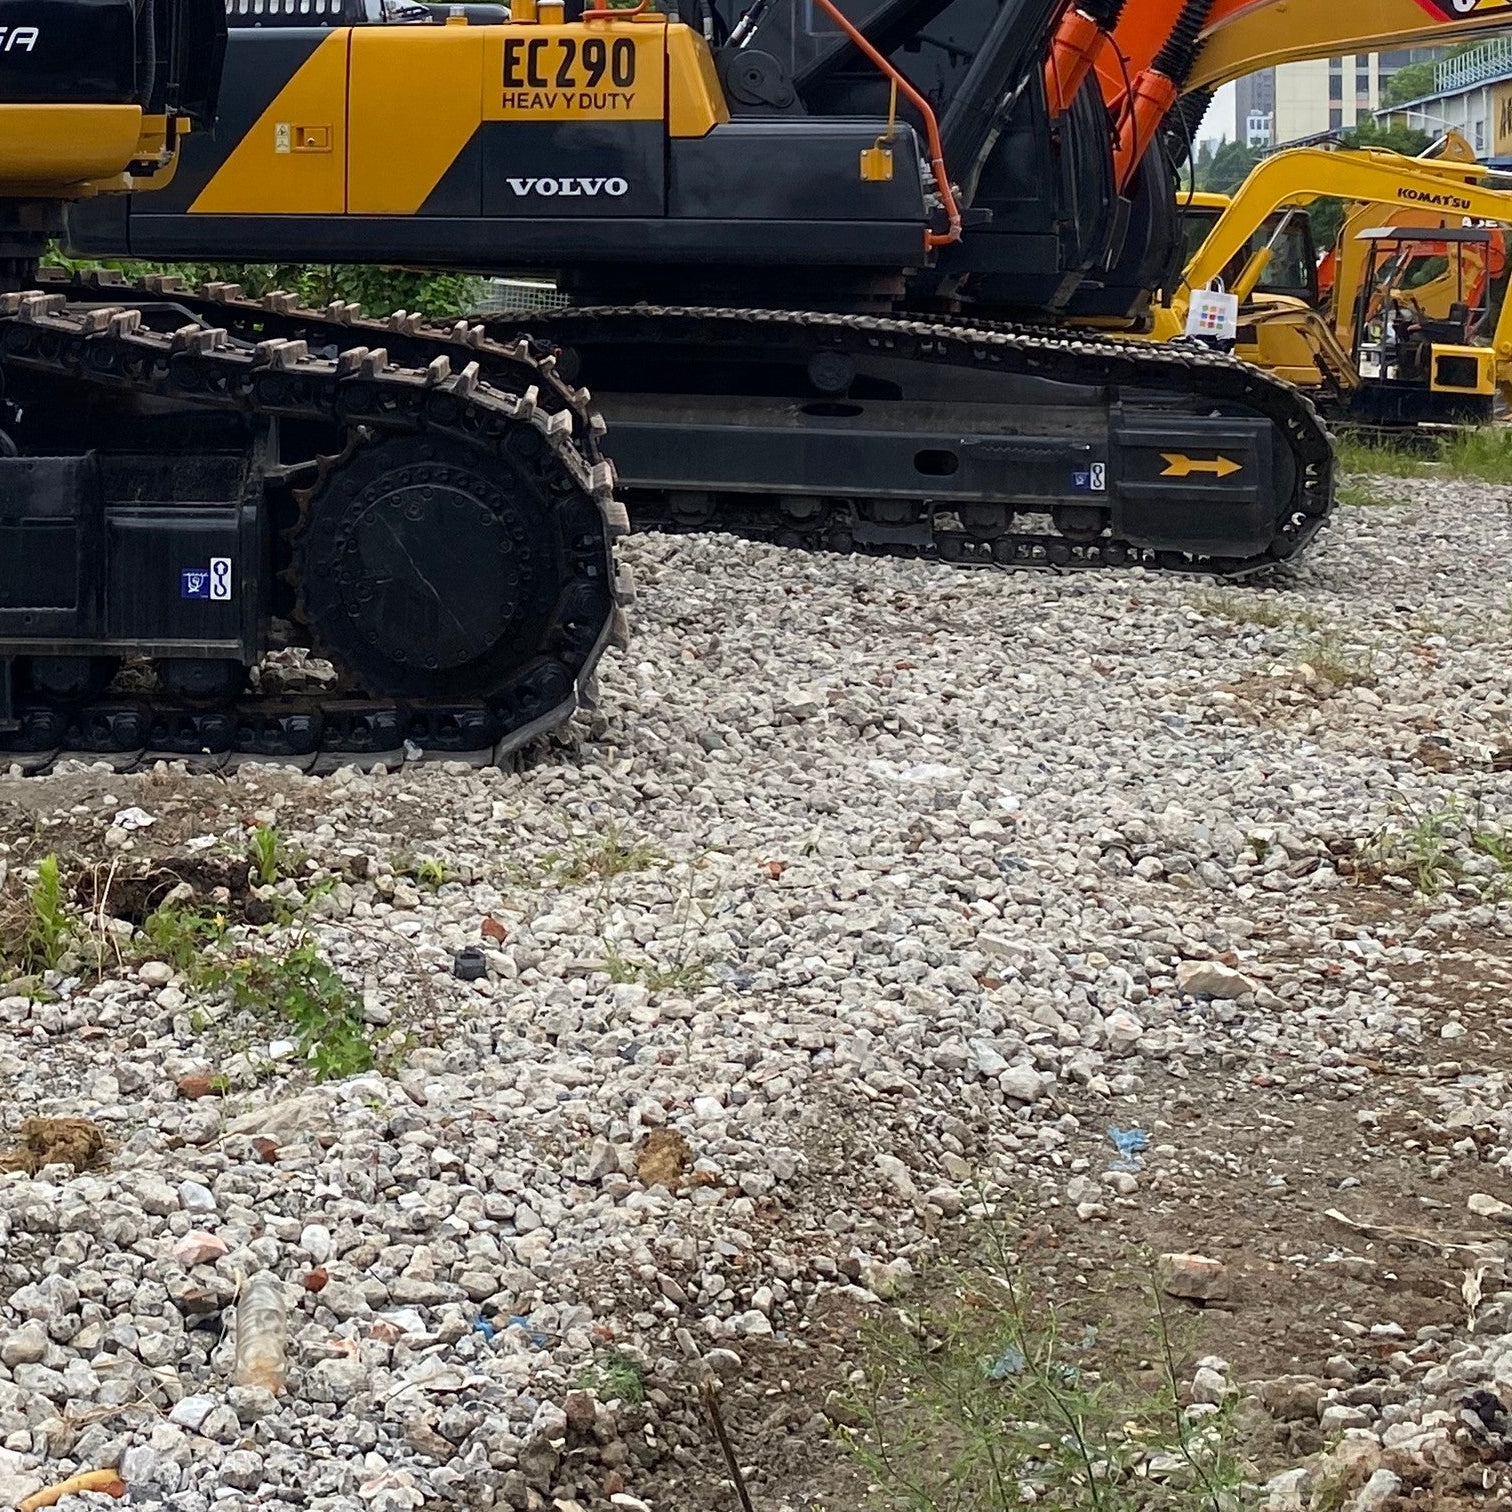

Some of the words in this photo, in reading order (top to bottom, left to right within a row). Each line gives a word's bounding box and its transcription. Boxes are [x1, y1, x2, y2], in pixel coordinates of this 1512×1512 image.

[503, 38, 636, 88] EC290
[506, 177, 629, 196] VOLVO
[1397, 188, 1471, 209] KOMATSU
